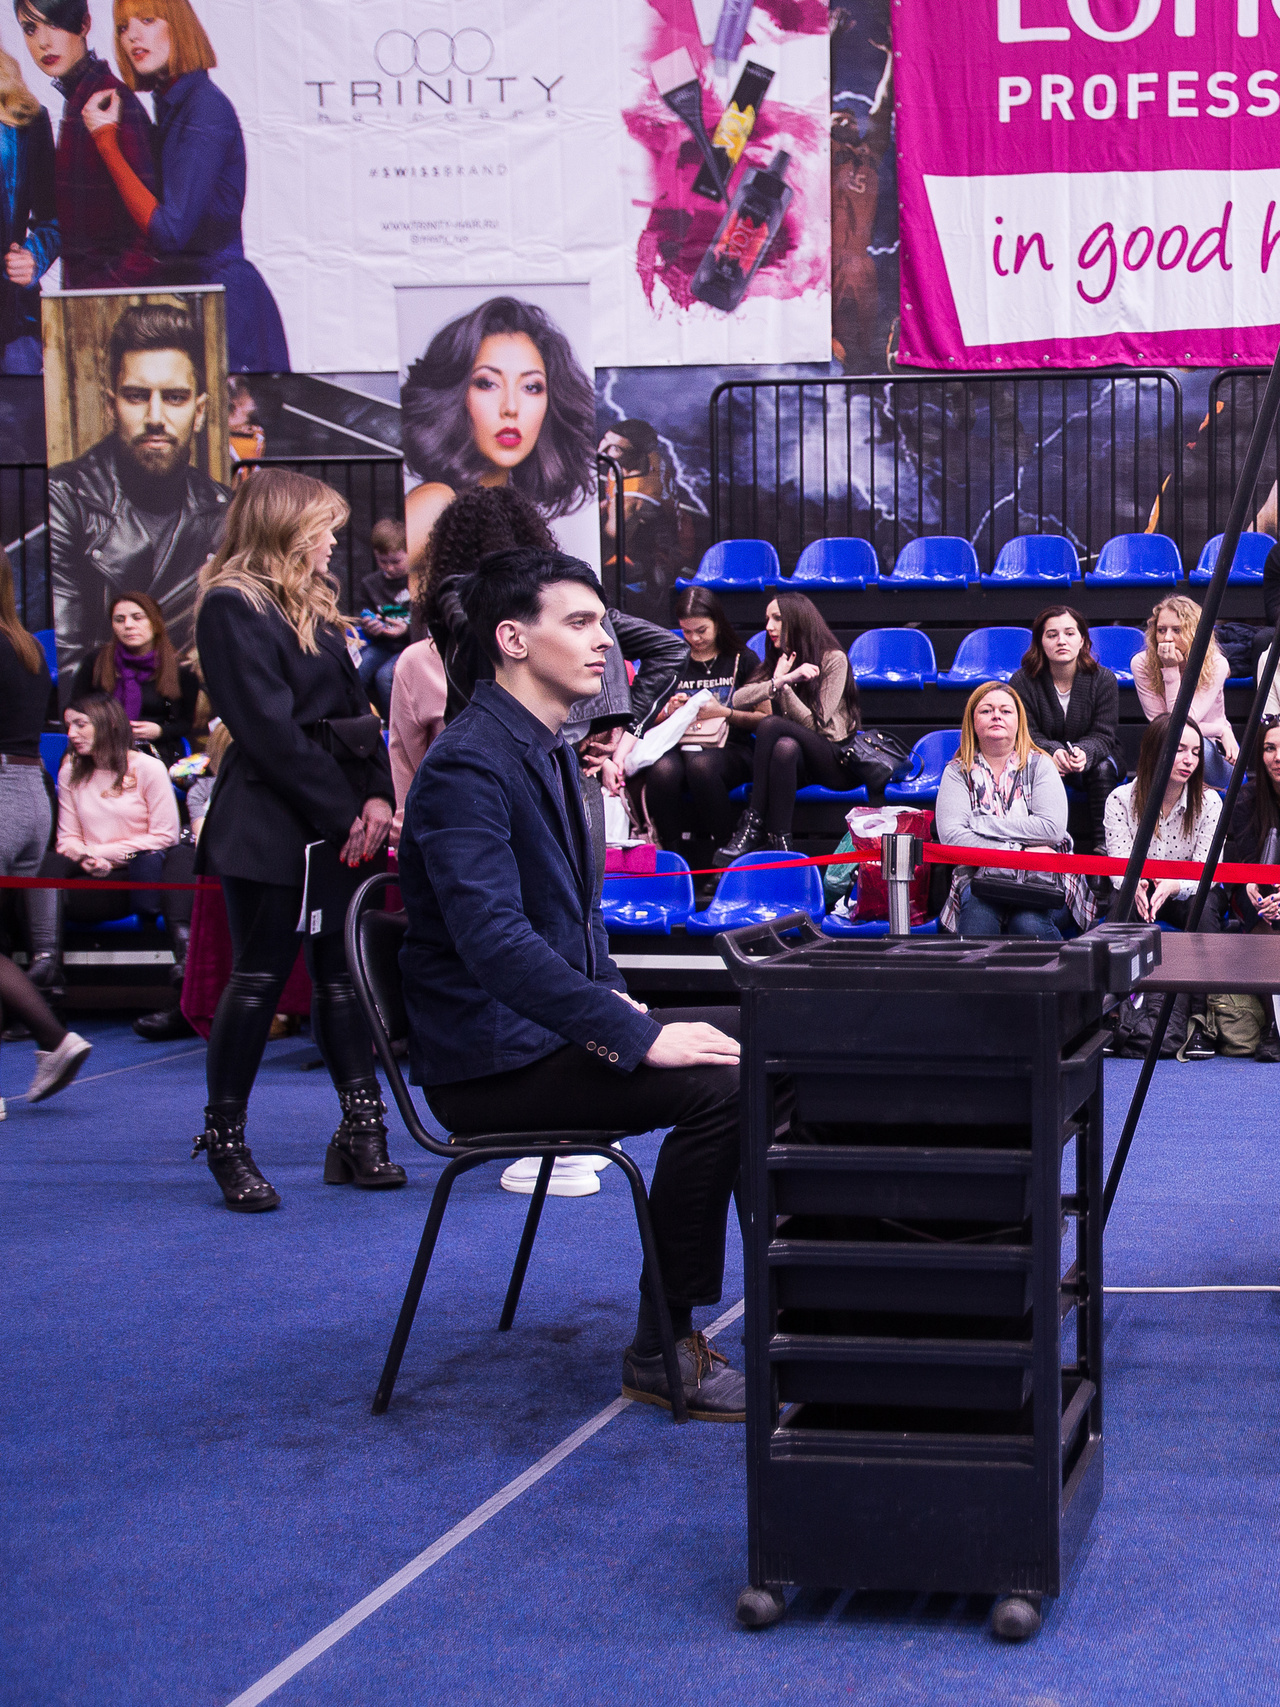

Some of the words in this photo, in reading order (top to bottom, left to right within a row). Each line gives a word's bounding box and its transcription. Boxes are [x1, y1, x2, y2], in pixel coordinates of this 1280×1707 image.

[304, 75, 564, 107] TRINITY
[992, 216, 1054, 276] in
[1077, 200, 1233, 304] good
